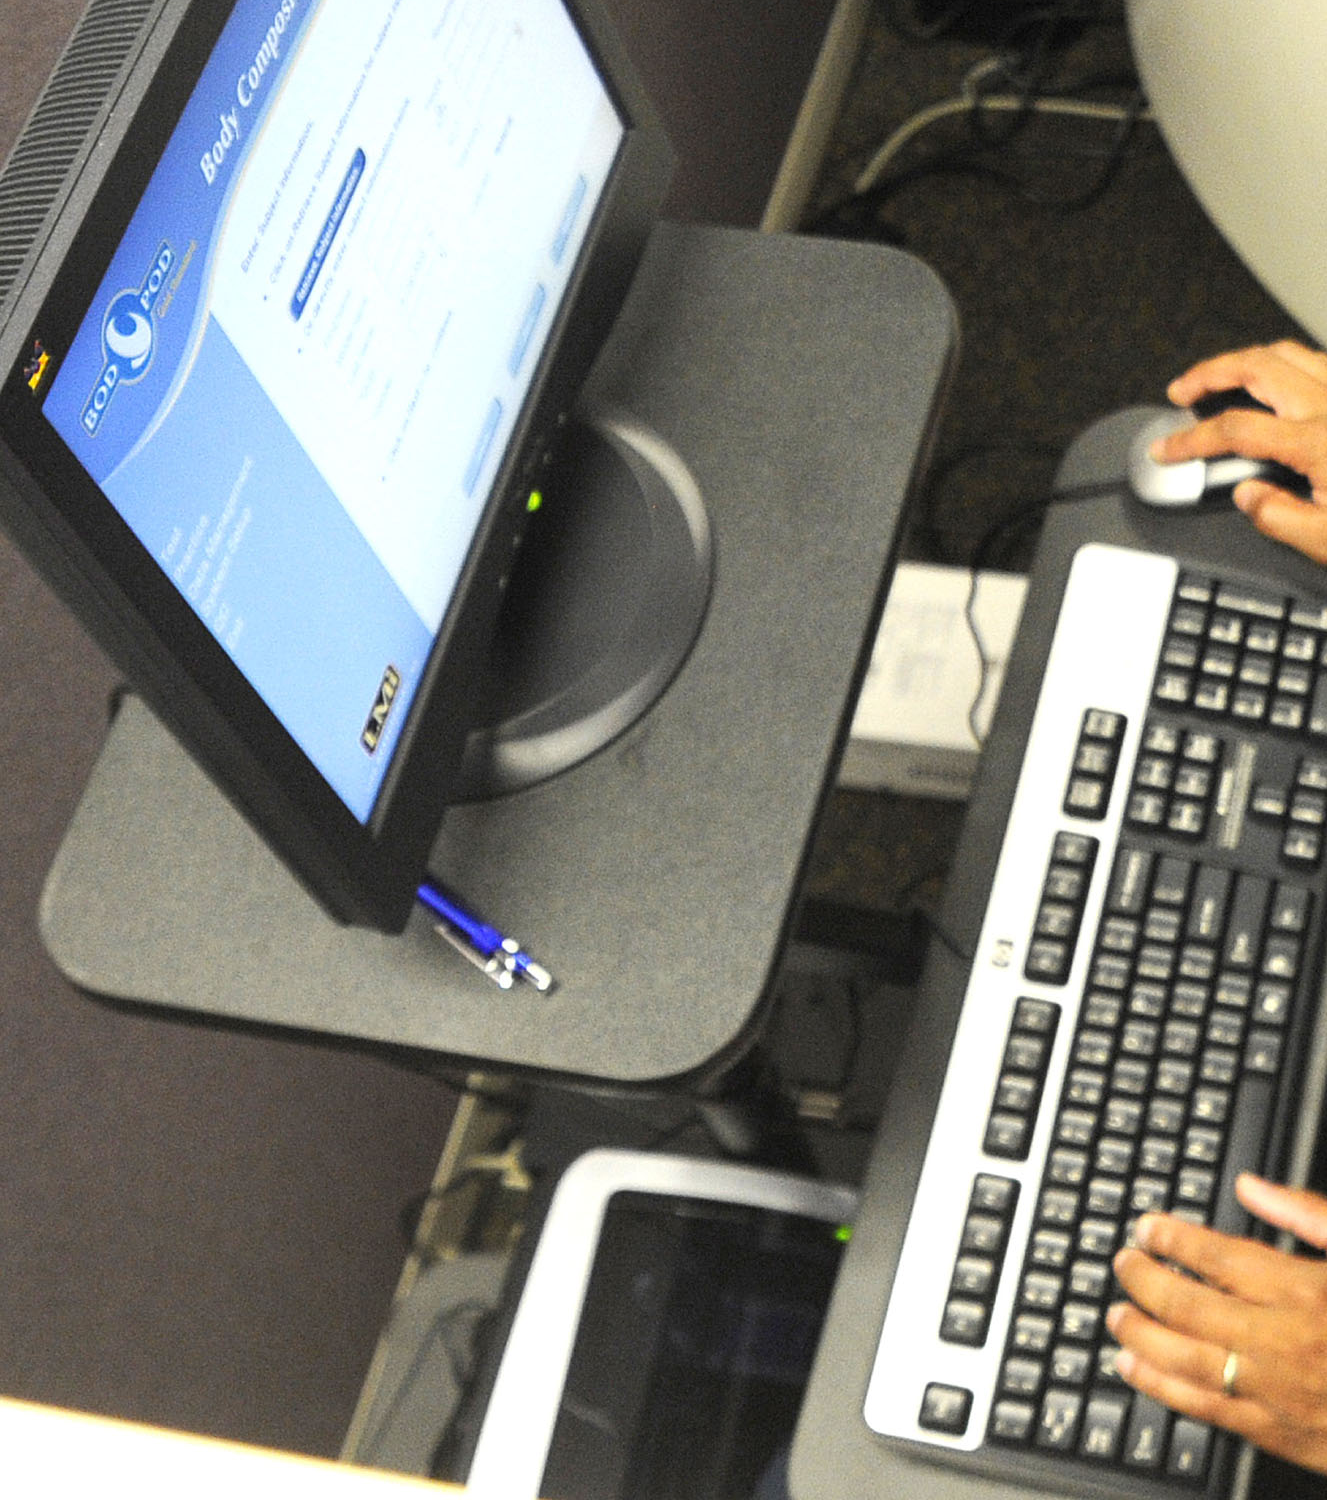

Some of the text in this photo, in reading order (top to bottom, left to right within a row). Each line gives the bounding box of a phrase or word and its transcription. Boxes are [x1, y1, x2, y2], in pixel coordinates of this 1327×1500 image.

[200, 107, 240, 186] Body
[83, 246, 174, 432] BOD POD
